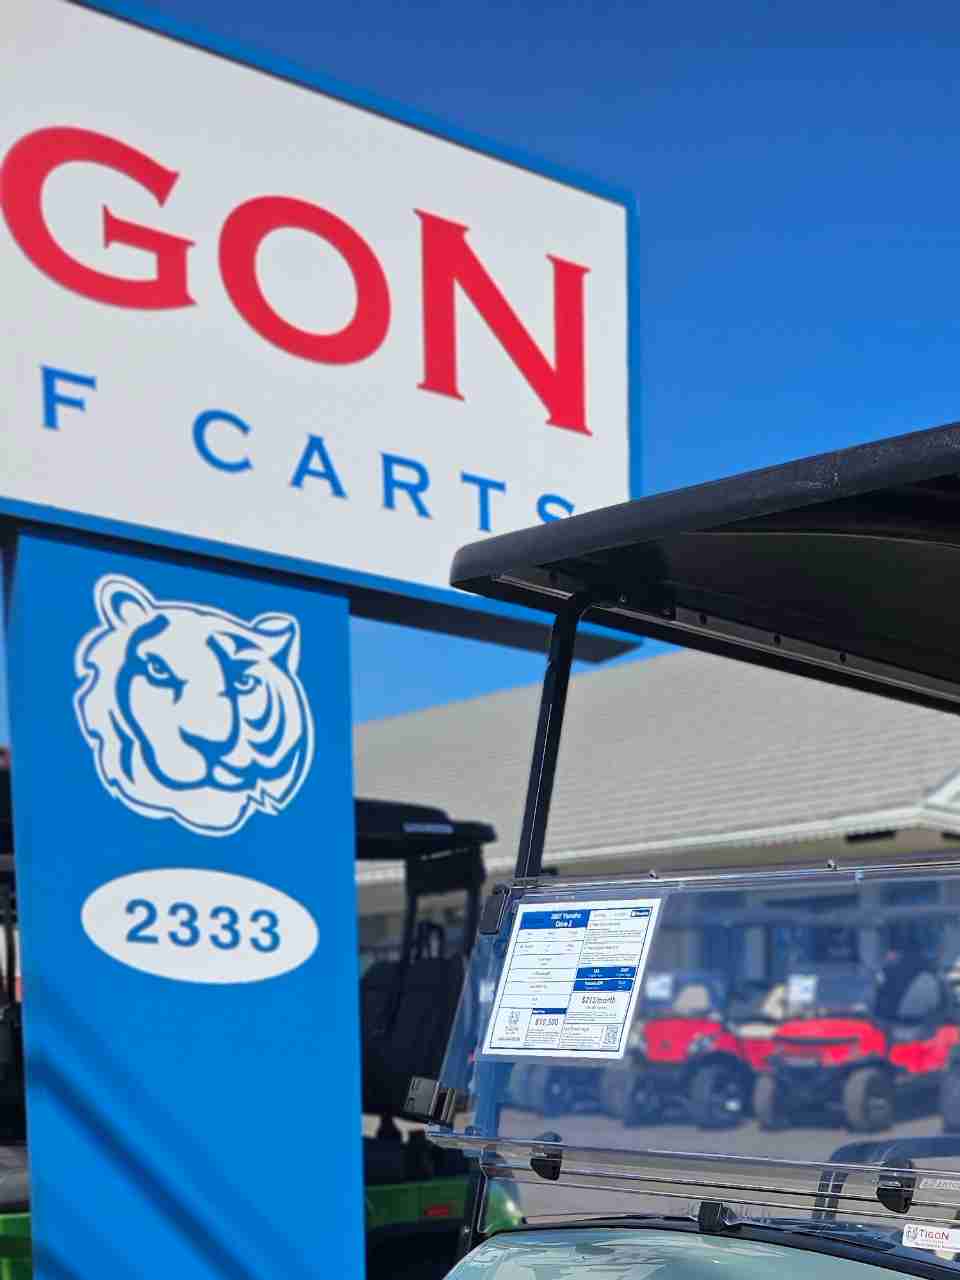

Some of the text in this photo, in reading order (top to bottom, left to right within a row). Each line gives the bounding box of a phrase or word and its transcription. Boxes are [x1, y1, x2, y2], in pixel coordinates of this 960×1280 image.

[0, 125, 593, 437] GON
[40, 364, 97, 430] F
[125, 898, 280, 953] 2333
[919, 1227, 950, 1241] TIGON
